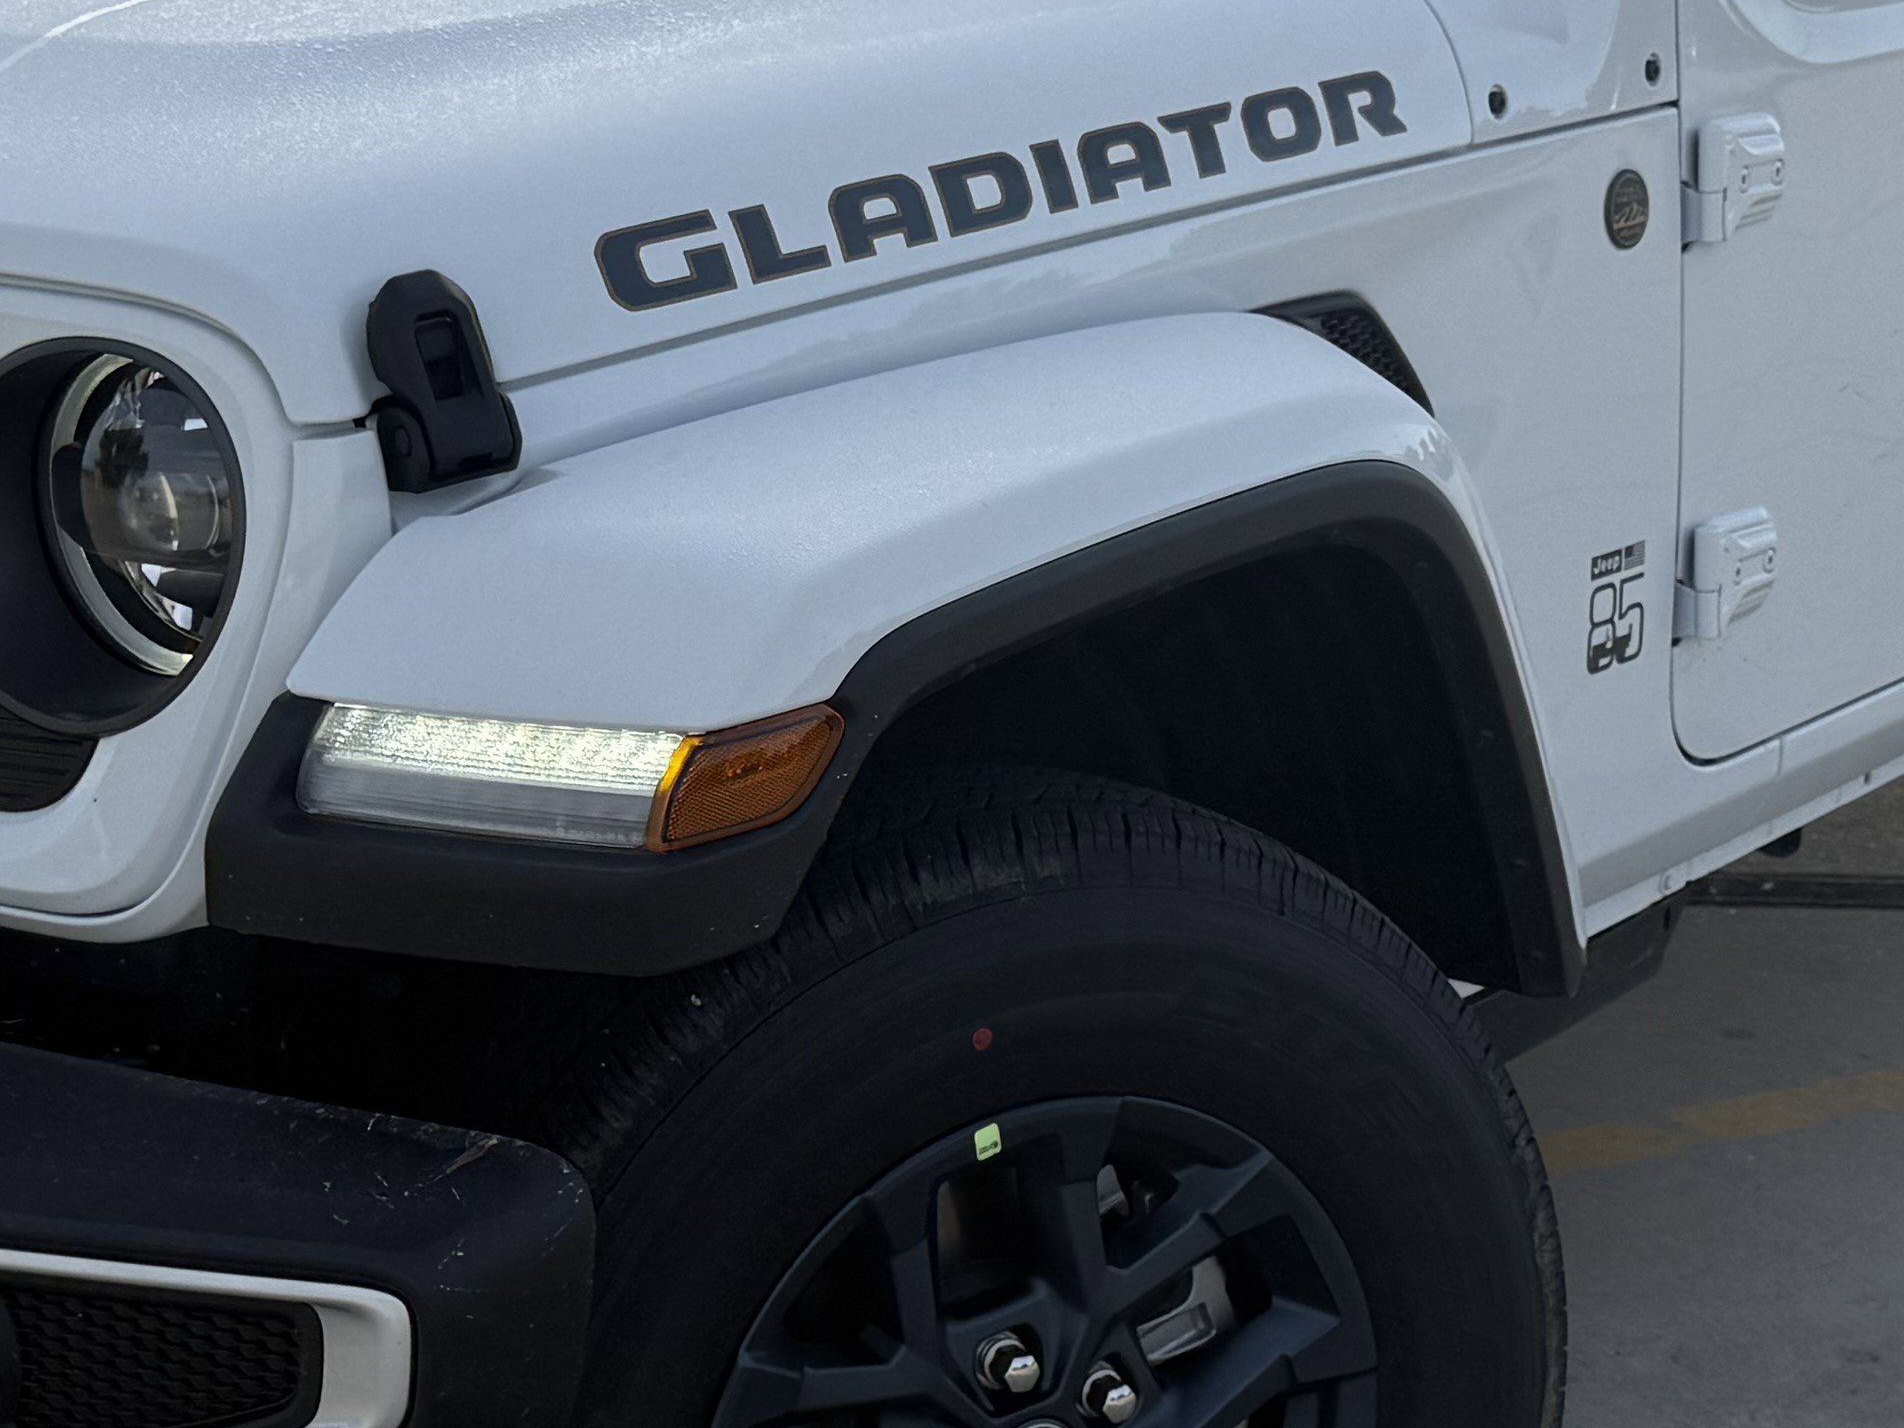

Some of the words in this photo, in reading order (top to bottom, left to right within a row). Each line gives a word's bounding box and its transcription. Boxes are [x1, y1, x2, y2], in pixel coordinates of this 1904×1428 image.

[593, 69, 1408, 312] GLADIATOR
[1593, 555, 1620, 575] Jeep
[1586, 572, 1645, 675] 85
